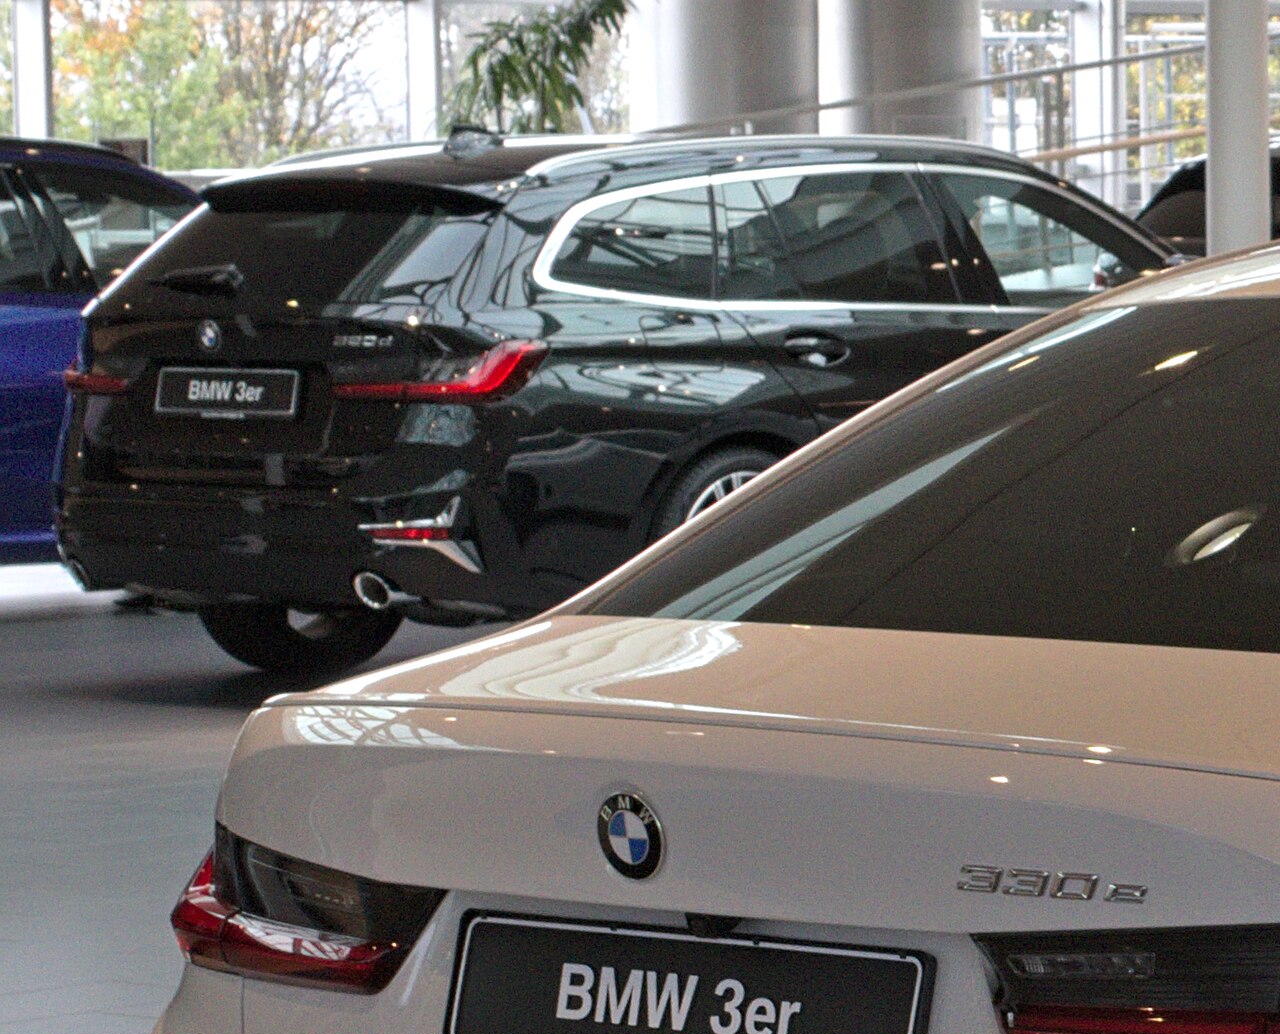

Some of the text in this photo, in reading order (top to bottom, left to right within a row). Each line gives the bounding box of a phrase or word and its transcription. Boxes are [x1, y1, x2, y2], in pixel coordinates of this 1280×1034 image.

[187, 379, 265, 401] BMW 3er
[600, 795, 654, 825] BMW
[957, 863, 1149, 904] 330e
[556, 962, 699, 1032] BMW
